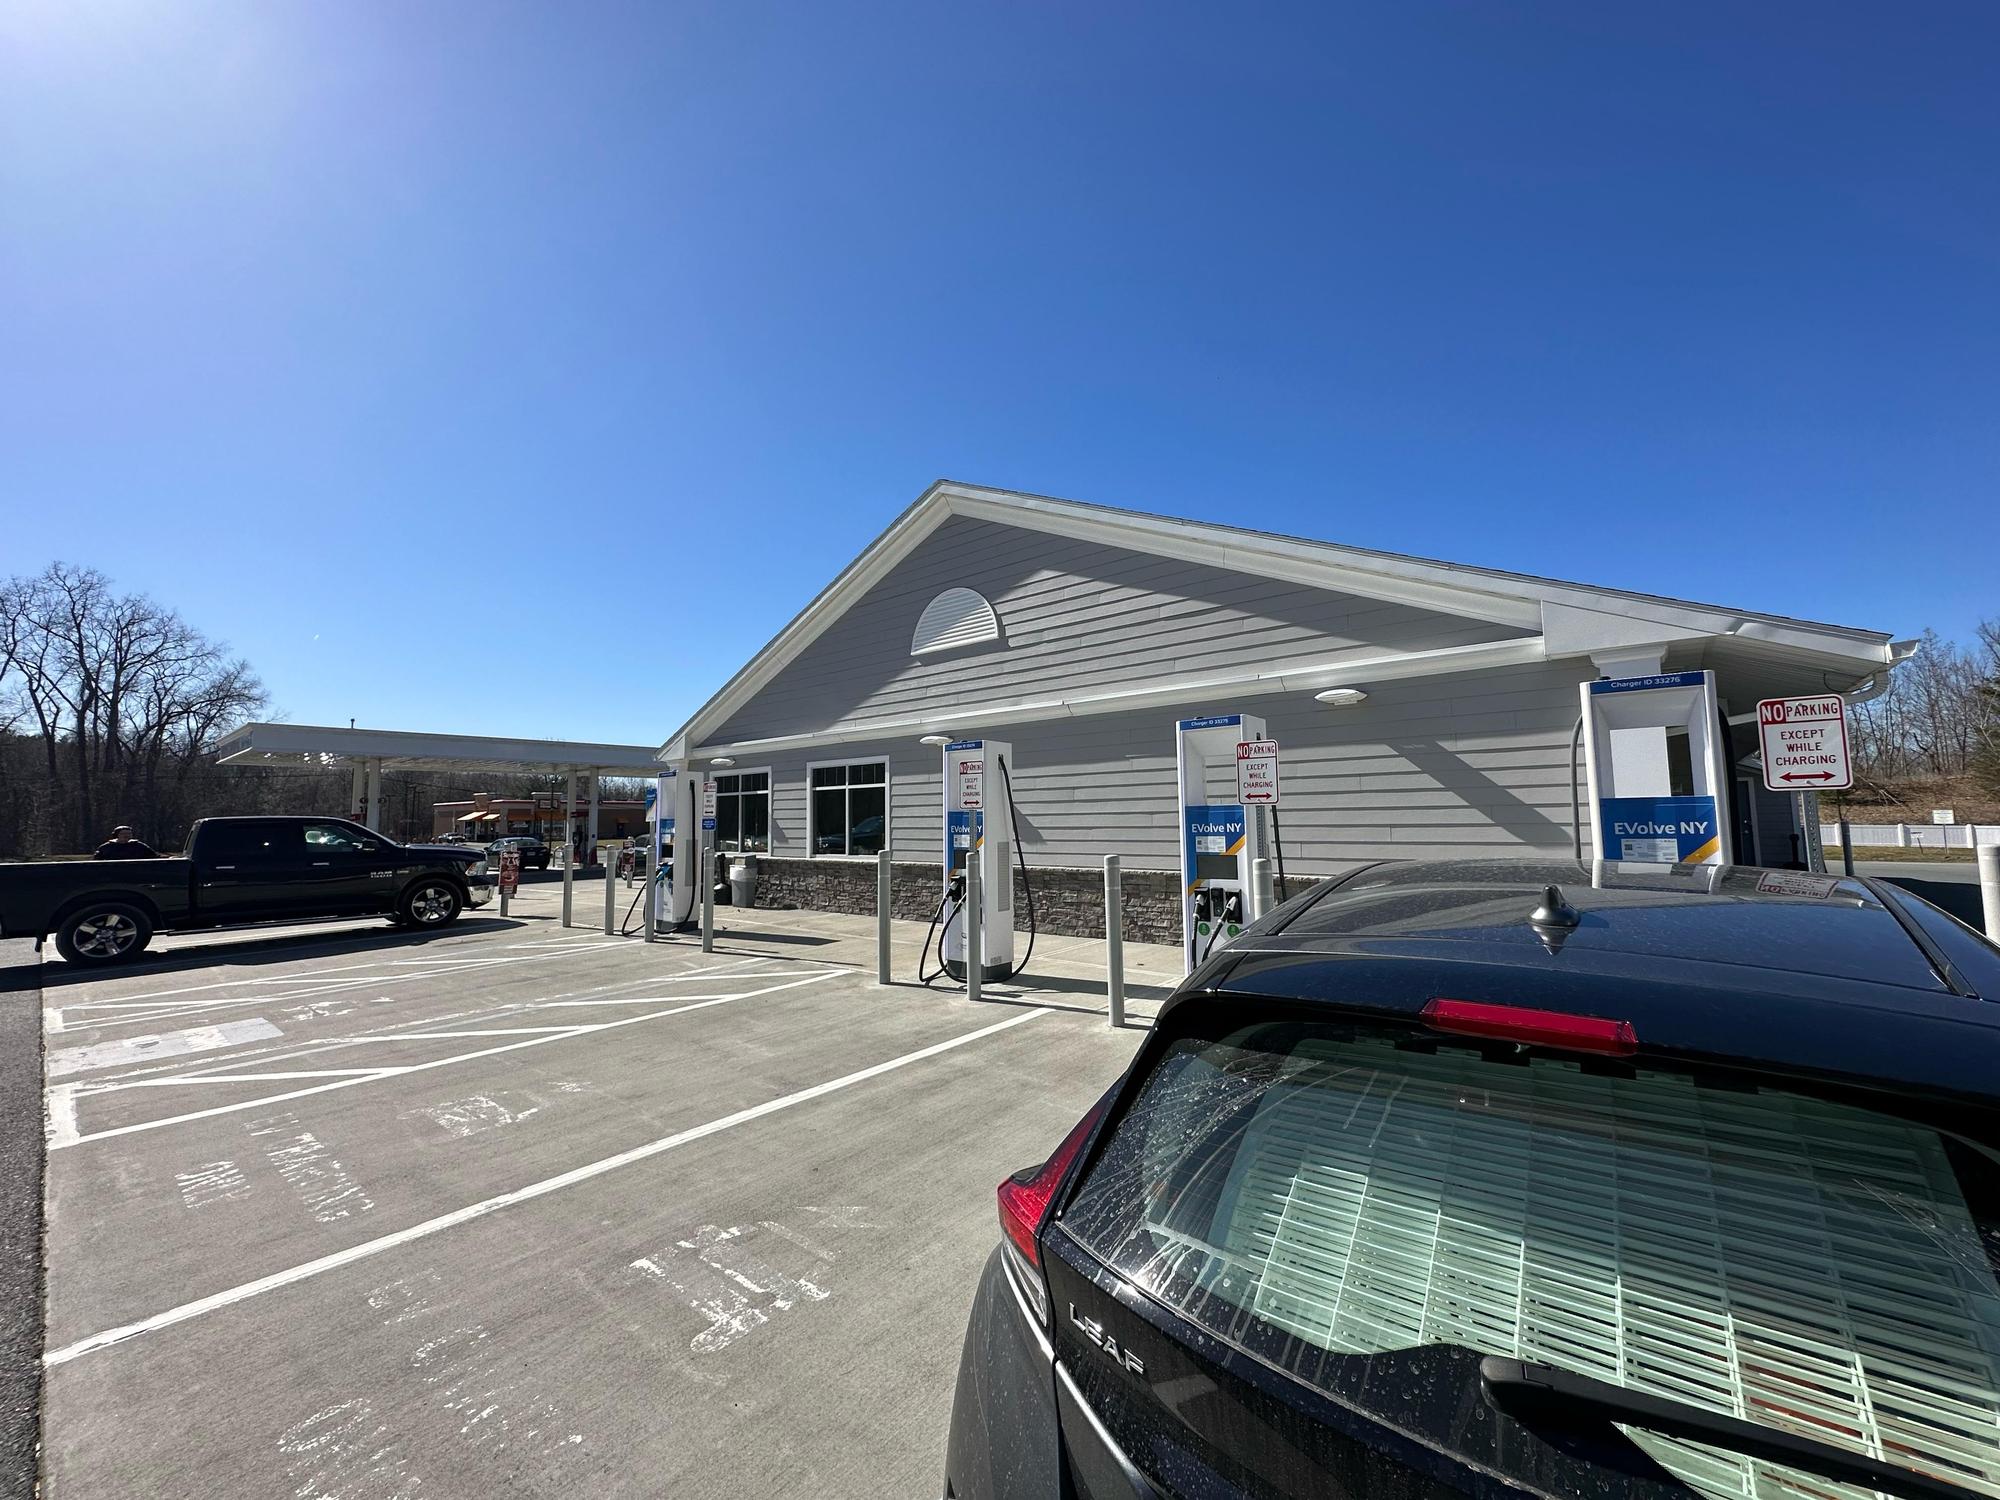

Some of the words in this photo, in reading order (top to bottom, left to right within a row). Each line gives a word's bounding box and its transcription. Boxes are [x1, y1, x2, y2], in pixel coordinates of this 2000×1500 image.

[1610, 680, 1642, 688] Charger
[1761, 704, 1784, 722] NO
[1786, 702, 1838, 717] PARKING
[1780, 728, 1825, 740] EXCEPT
[1238, 745, 1249, 758] NO
[1249, 744, 1275, 755] PARKING
[1786, 742, 1823, 752] WHILE
[1775, 754, 1837, 766] CHARGING
[1246, 763, 1268, 771] EXCEPT
[1243, 780, 1274, 789] CHARGING
[1191, 822, 1225, 833] EVolve
[1226, 822, 1242, 833] NY
[1613, 821, 1677, 835] EVolve
[1680, 821, 1709, 834] NY
[1069, 1301, 1144, 1375] LEAF
